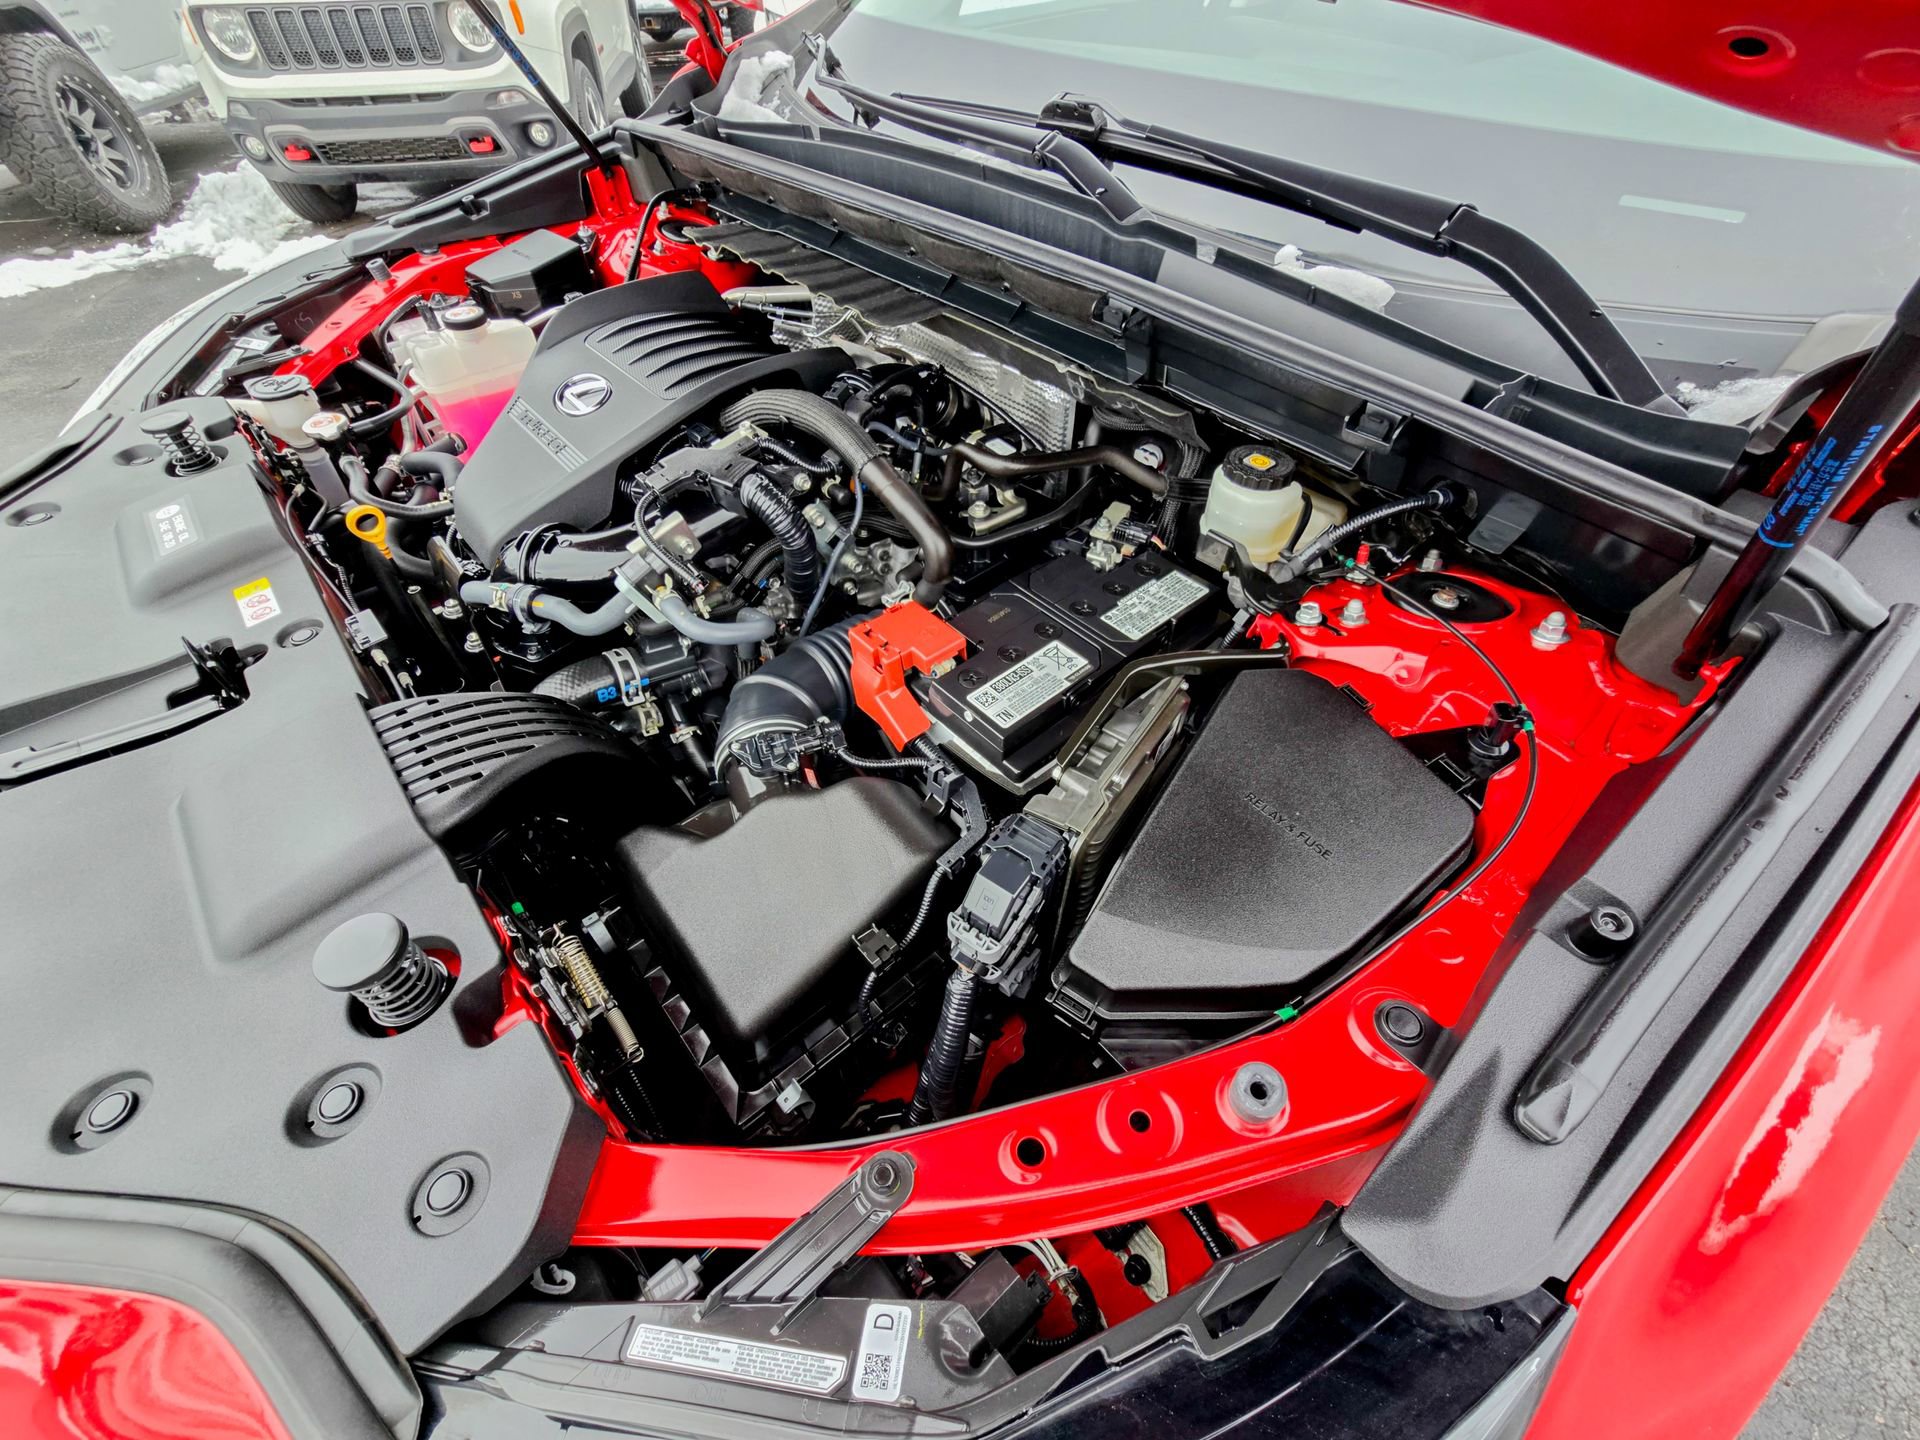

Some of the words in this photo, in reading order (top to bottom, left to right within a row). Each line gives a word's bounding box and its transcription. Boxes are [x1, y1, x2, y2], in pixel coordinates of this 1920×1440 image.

[1832, 424, 1883, 482] STABILUS
[597, 687, 617, 703] B3
[996, 709, 1014, 722] TN
[1244, 792, 1288, 825] RELAY
[1296, 831, 1333, 861] FUSE
[873, 1313, 894, 1331] D
